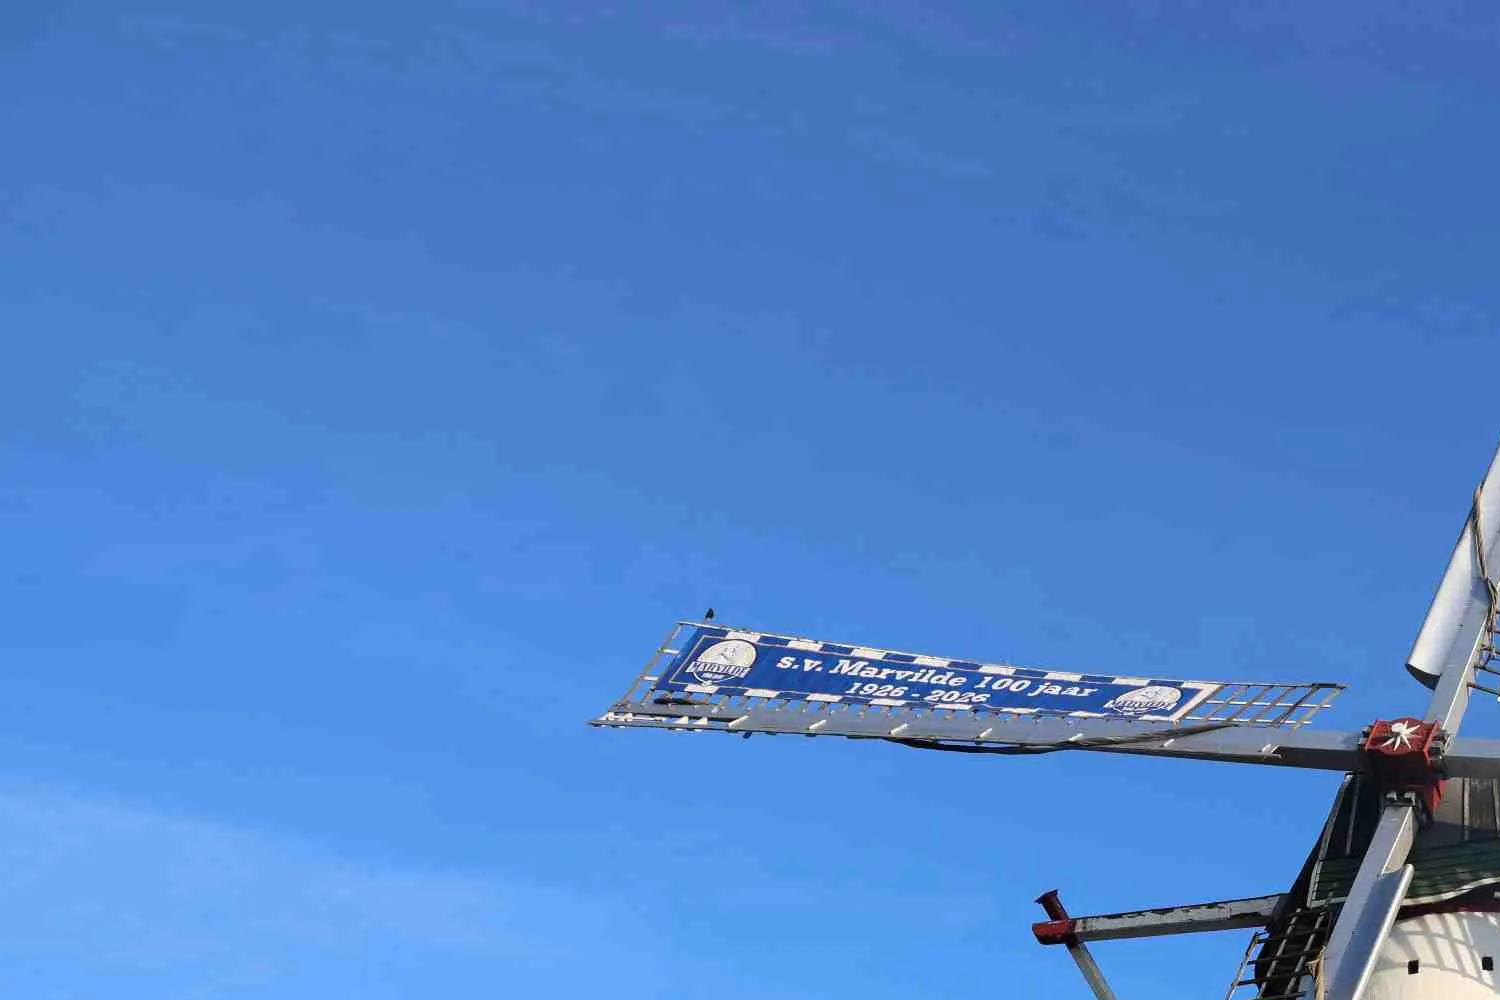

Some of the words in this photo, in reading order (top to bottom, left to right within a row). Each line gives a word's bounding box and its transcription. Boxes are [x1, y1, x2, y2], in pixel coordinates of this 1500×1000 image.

[776, 656, 823, 672] s.v.
[828, 659, 967, 686] Marvilde
[974, 676, 1032, 692] 100
[1028, 682, 1098, 697] jaar
[846, 682, 909, 697] 1926
[924, 689, 991, 703] 2026
